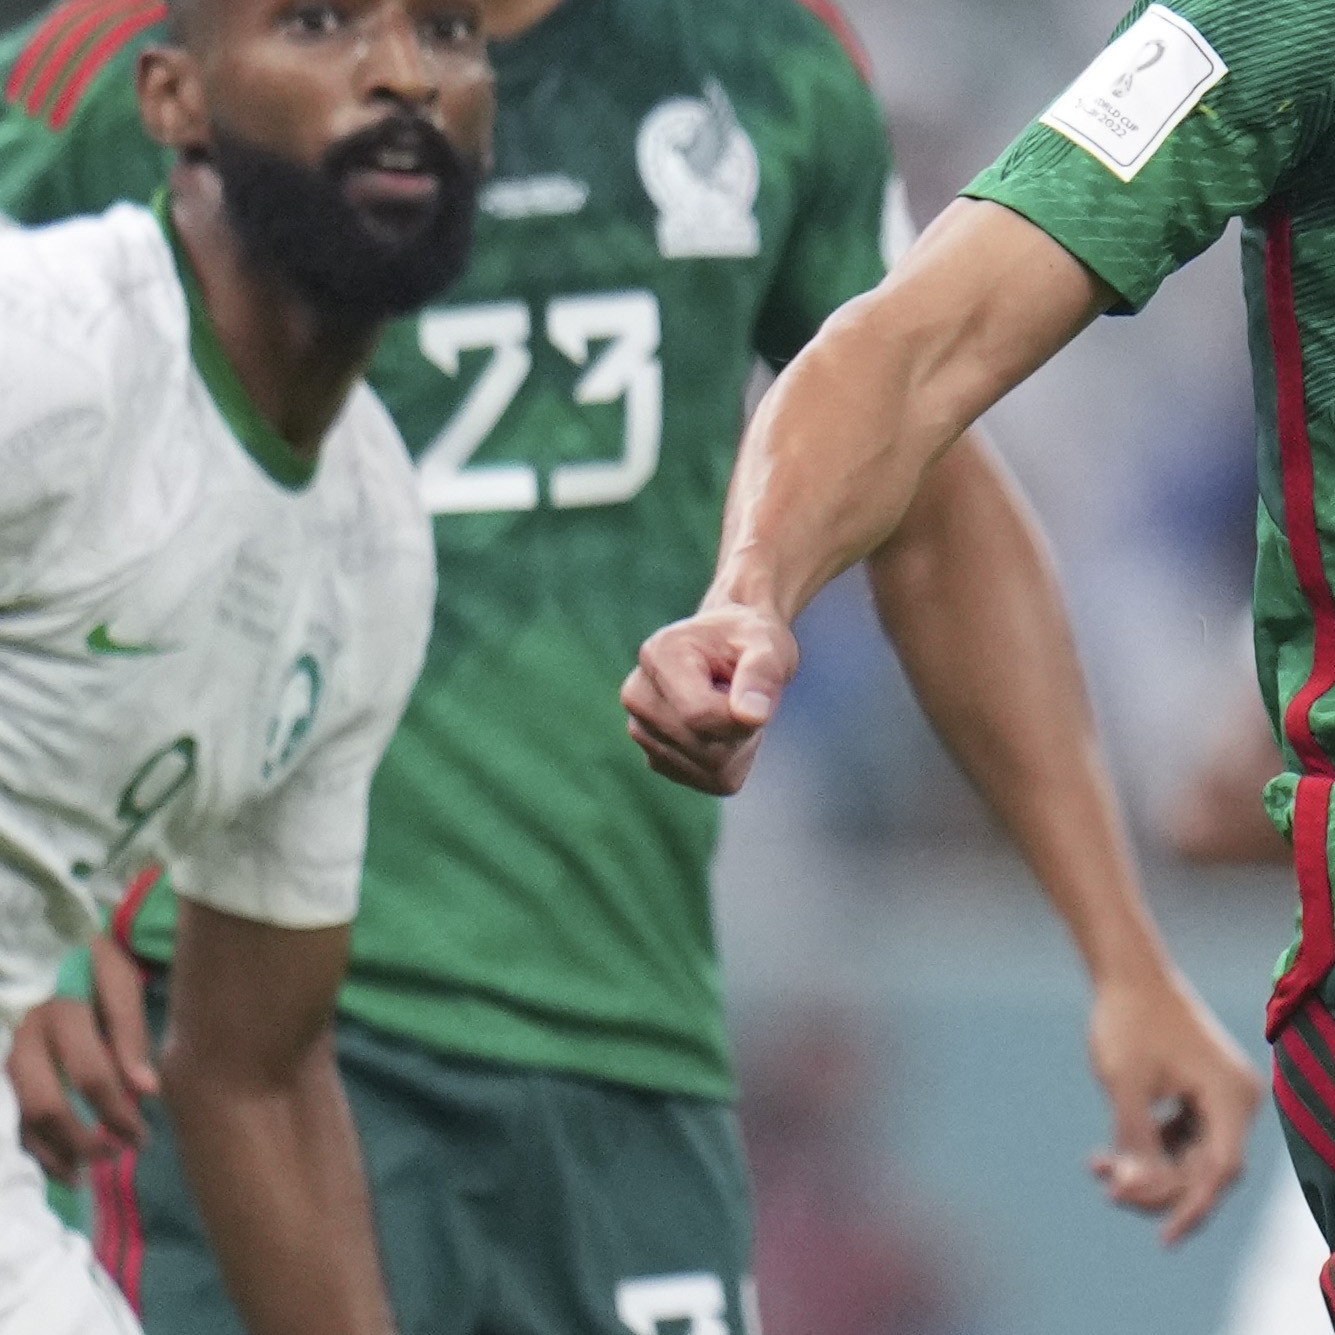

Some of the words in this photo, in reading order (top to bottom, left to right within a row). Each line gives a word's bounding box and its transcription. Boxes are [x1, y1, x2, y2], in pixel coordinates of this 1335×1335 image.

[1100, 116, 1128, 139] 2022
[1120, 115, 1140, 133] CUP
[417, 286, 664, 512] 23
